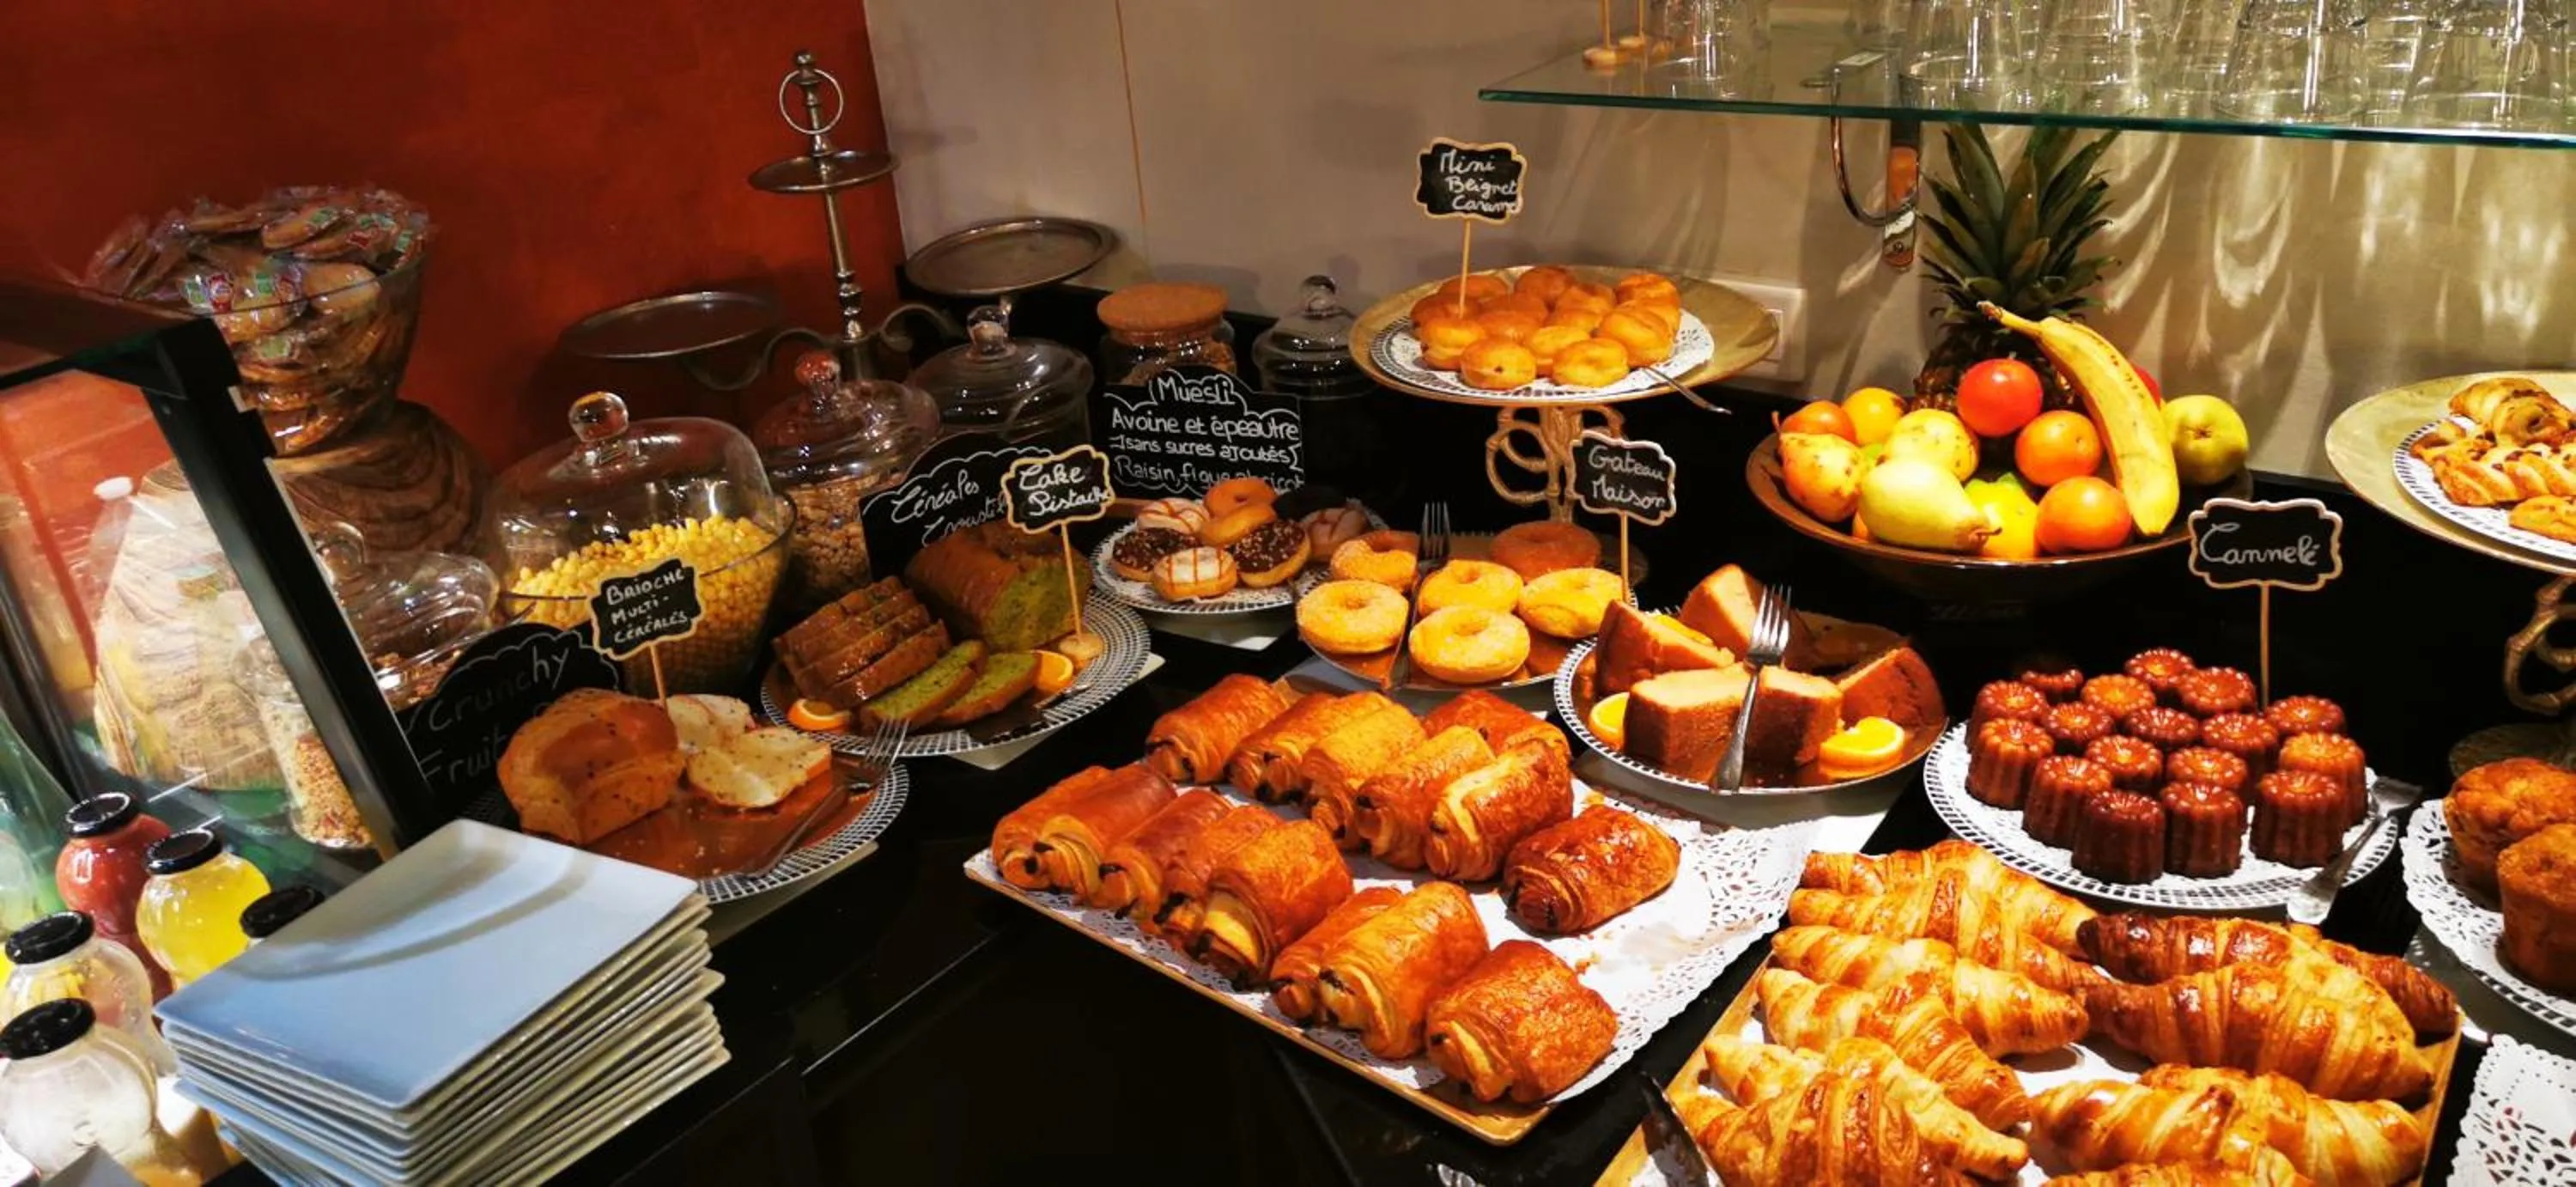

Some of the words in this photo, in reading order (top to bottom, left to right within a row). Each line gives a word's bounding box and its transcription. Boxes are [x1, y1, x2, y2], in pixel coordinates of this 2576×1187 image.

[1440, 149, 1495, 173] Mini
[1444, 176, 1517, 199] Beignet
[1158, 376, 1236, 405] Muesli
[1112, 408, 1181, 434] Avoine
[1185, 417, 1207, 435] et
[1211, 416, 1299, 442] épeautre
[1165, 441, 1215, 456] sucres
[1589, 445, 1665, 481] Gateau
[1019, 464, 1086, 490] Cake
[1592, 474, 1665, 508] Maison
[890, 469, 980, 523] Céréales
[2200, 522, 2320, 566] Cannelé
[428, 645, 569, 732] Crunchy
